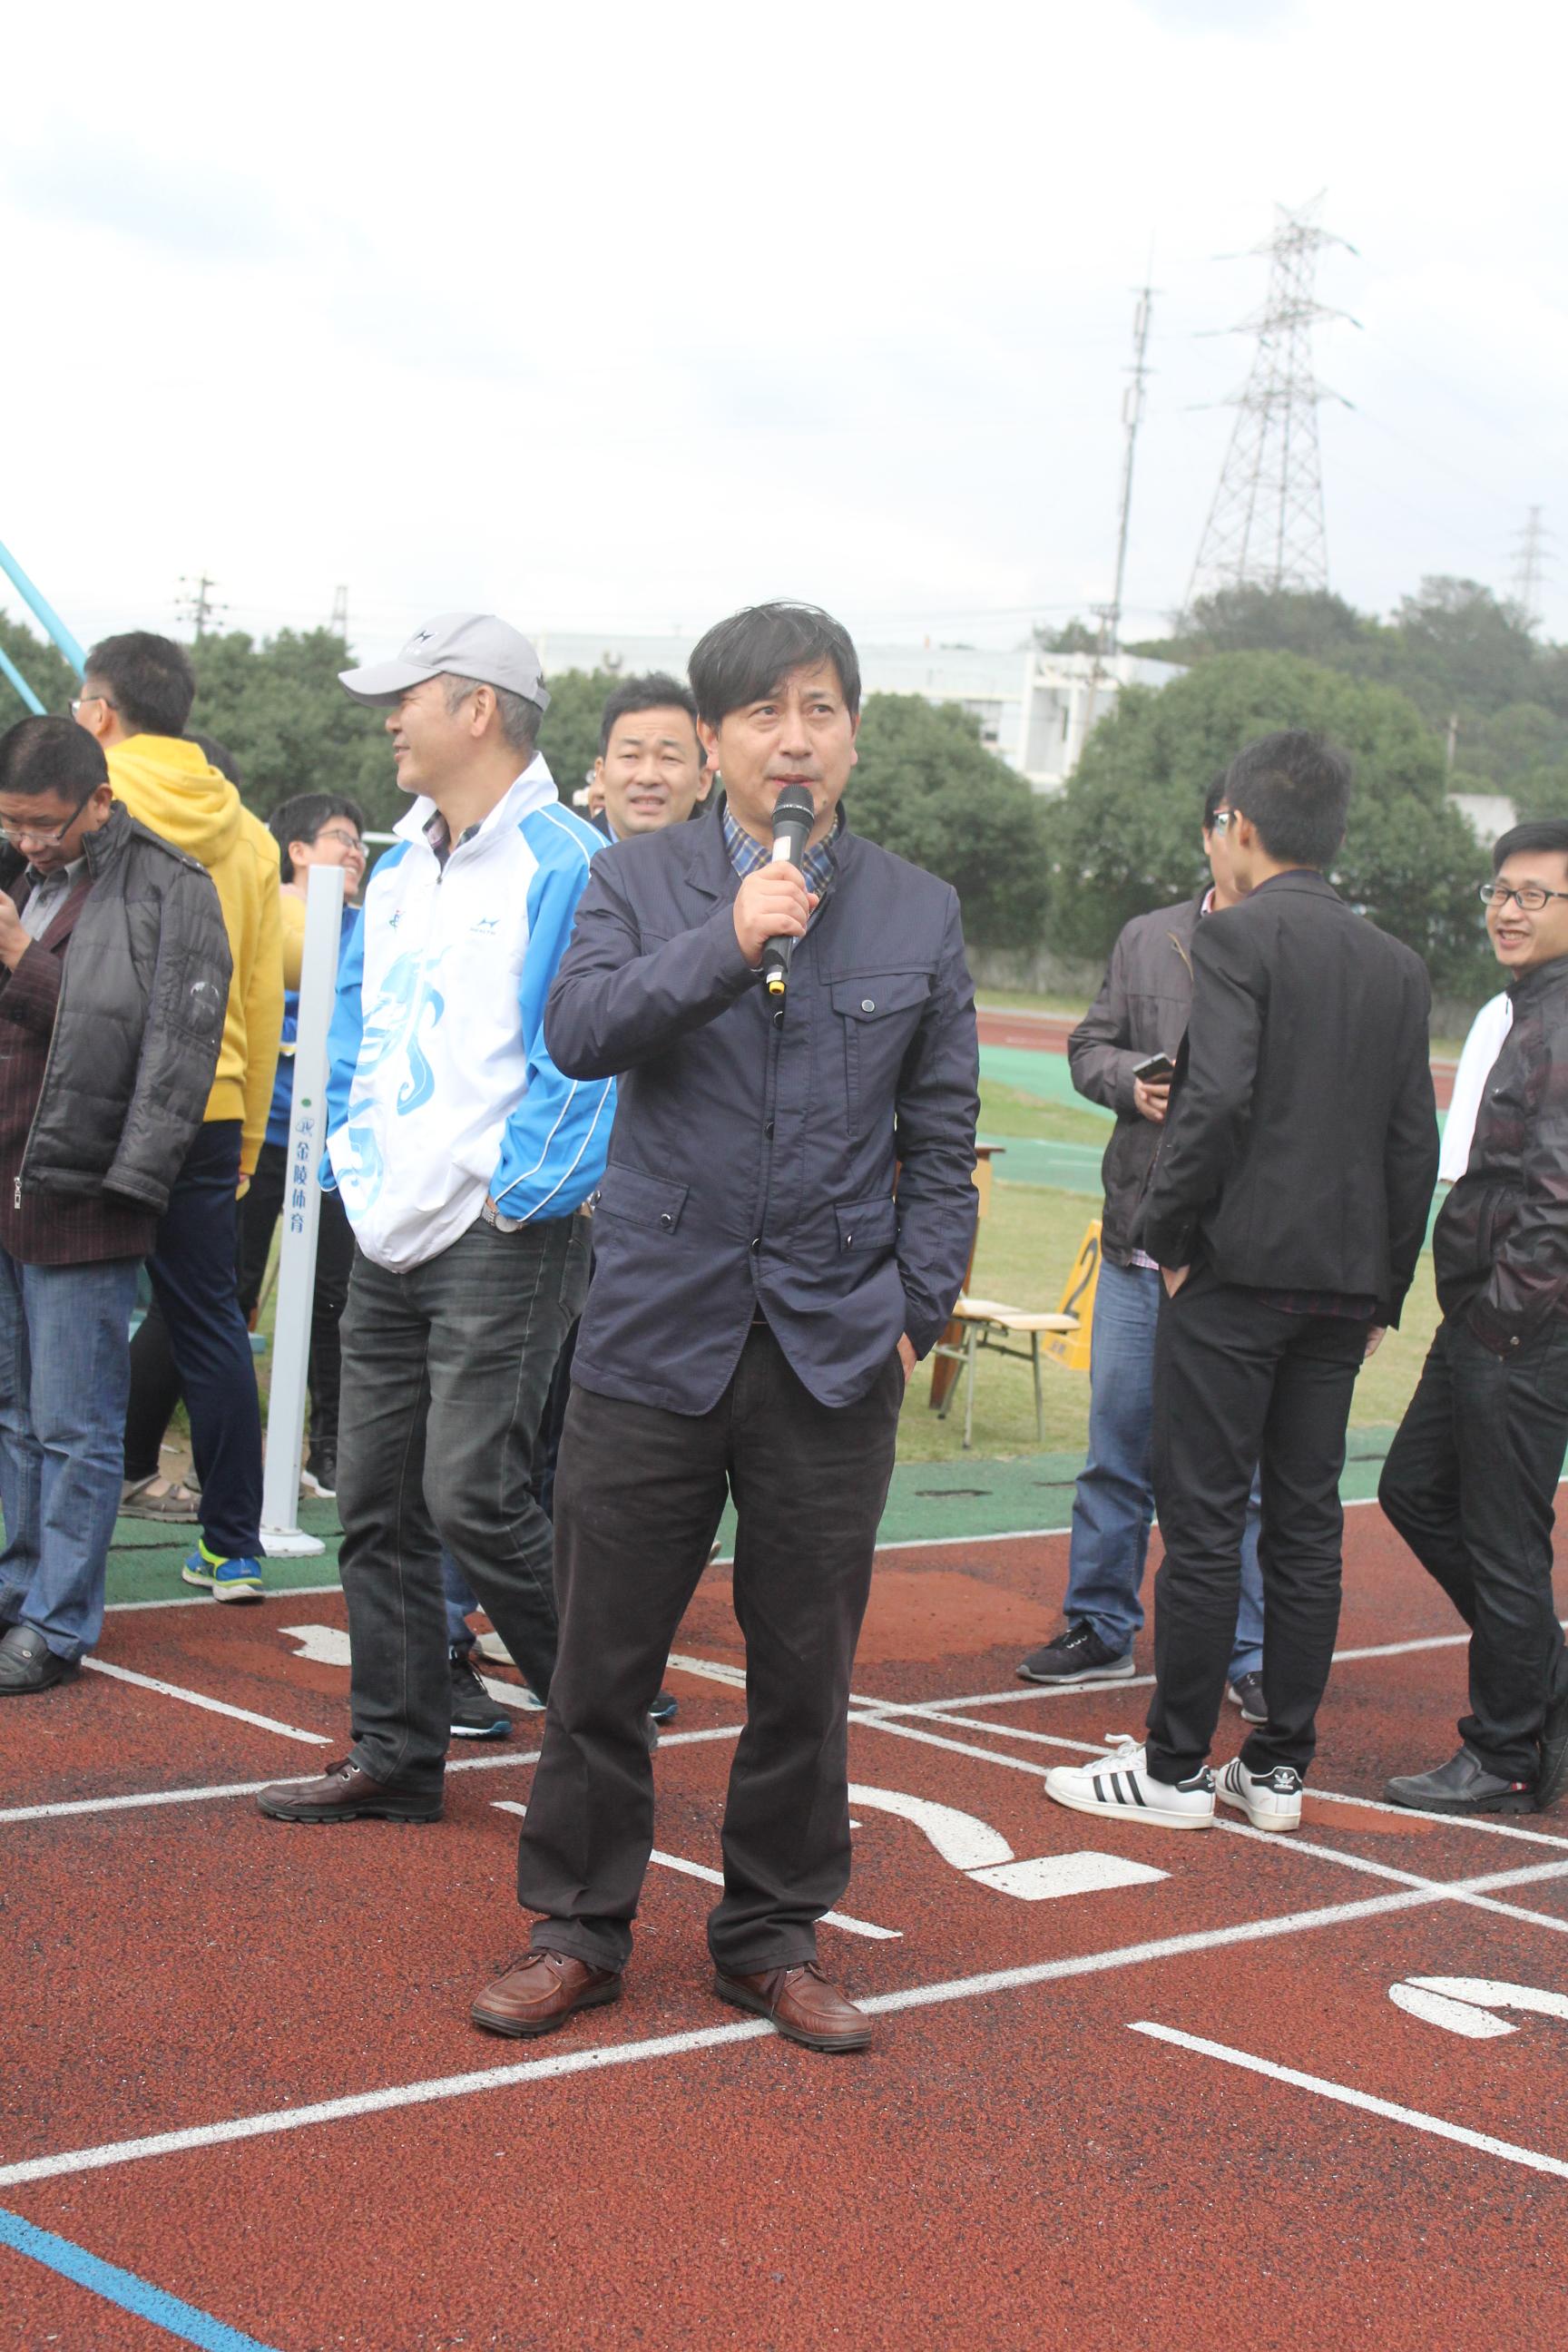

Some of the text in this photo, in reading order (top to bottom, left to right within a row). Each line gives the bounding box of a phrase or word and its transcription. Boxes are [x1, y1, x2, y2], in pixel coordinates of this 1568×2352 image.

[290, 1141, 310, 1234] 金陵体育
[1062, 1237, 1098, 1320] 2
